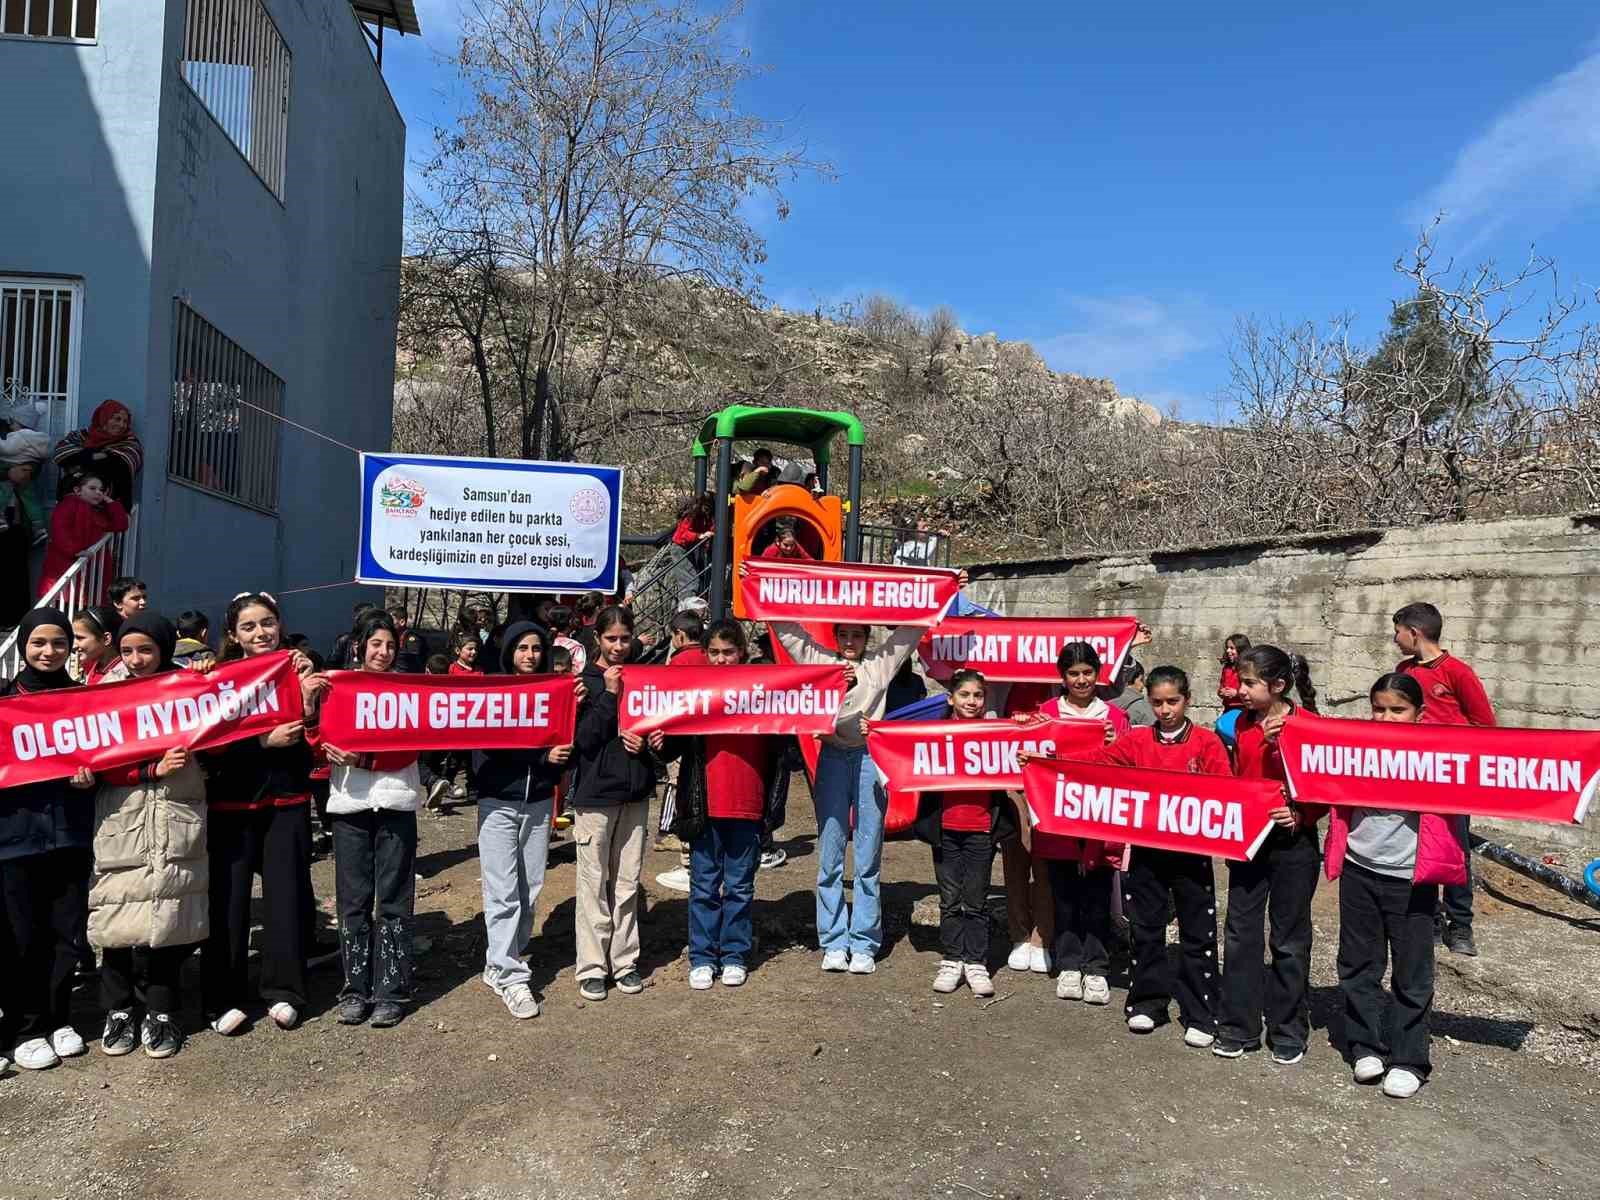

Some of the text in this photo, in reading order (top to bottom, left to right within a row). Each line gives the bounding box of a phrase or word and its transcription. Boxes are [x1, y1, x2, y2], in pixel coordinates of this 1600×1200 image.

[463, 487, 531, 504] Samsun'dan
[430, 506, 562, 527] hediye edilen bu parkta
[420, 528, 571, 549] yankılanan her çocuk sesi,
[389, 546, 597, 569] kardeşliğimizin en güzel ezgisi olsun.
[759, 576, 940, 609] NURULLAH ERGÜL
[932, 634, 1116, 665] MURAT KALCI
[355, 692, 549, 729] RON GEZELLE
[627, 682, 839, 717] CÜNEYT SAĞIROĞLU
[12, 679, 279, 761] OLGUN AYDOĞAN
[912, 734, 955, 776] ALİ
[1301, 743, 1581, 793] MUHAMMET ERKAN
[1054, 773, 1244, 842] İSMET KOCA
